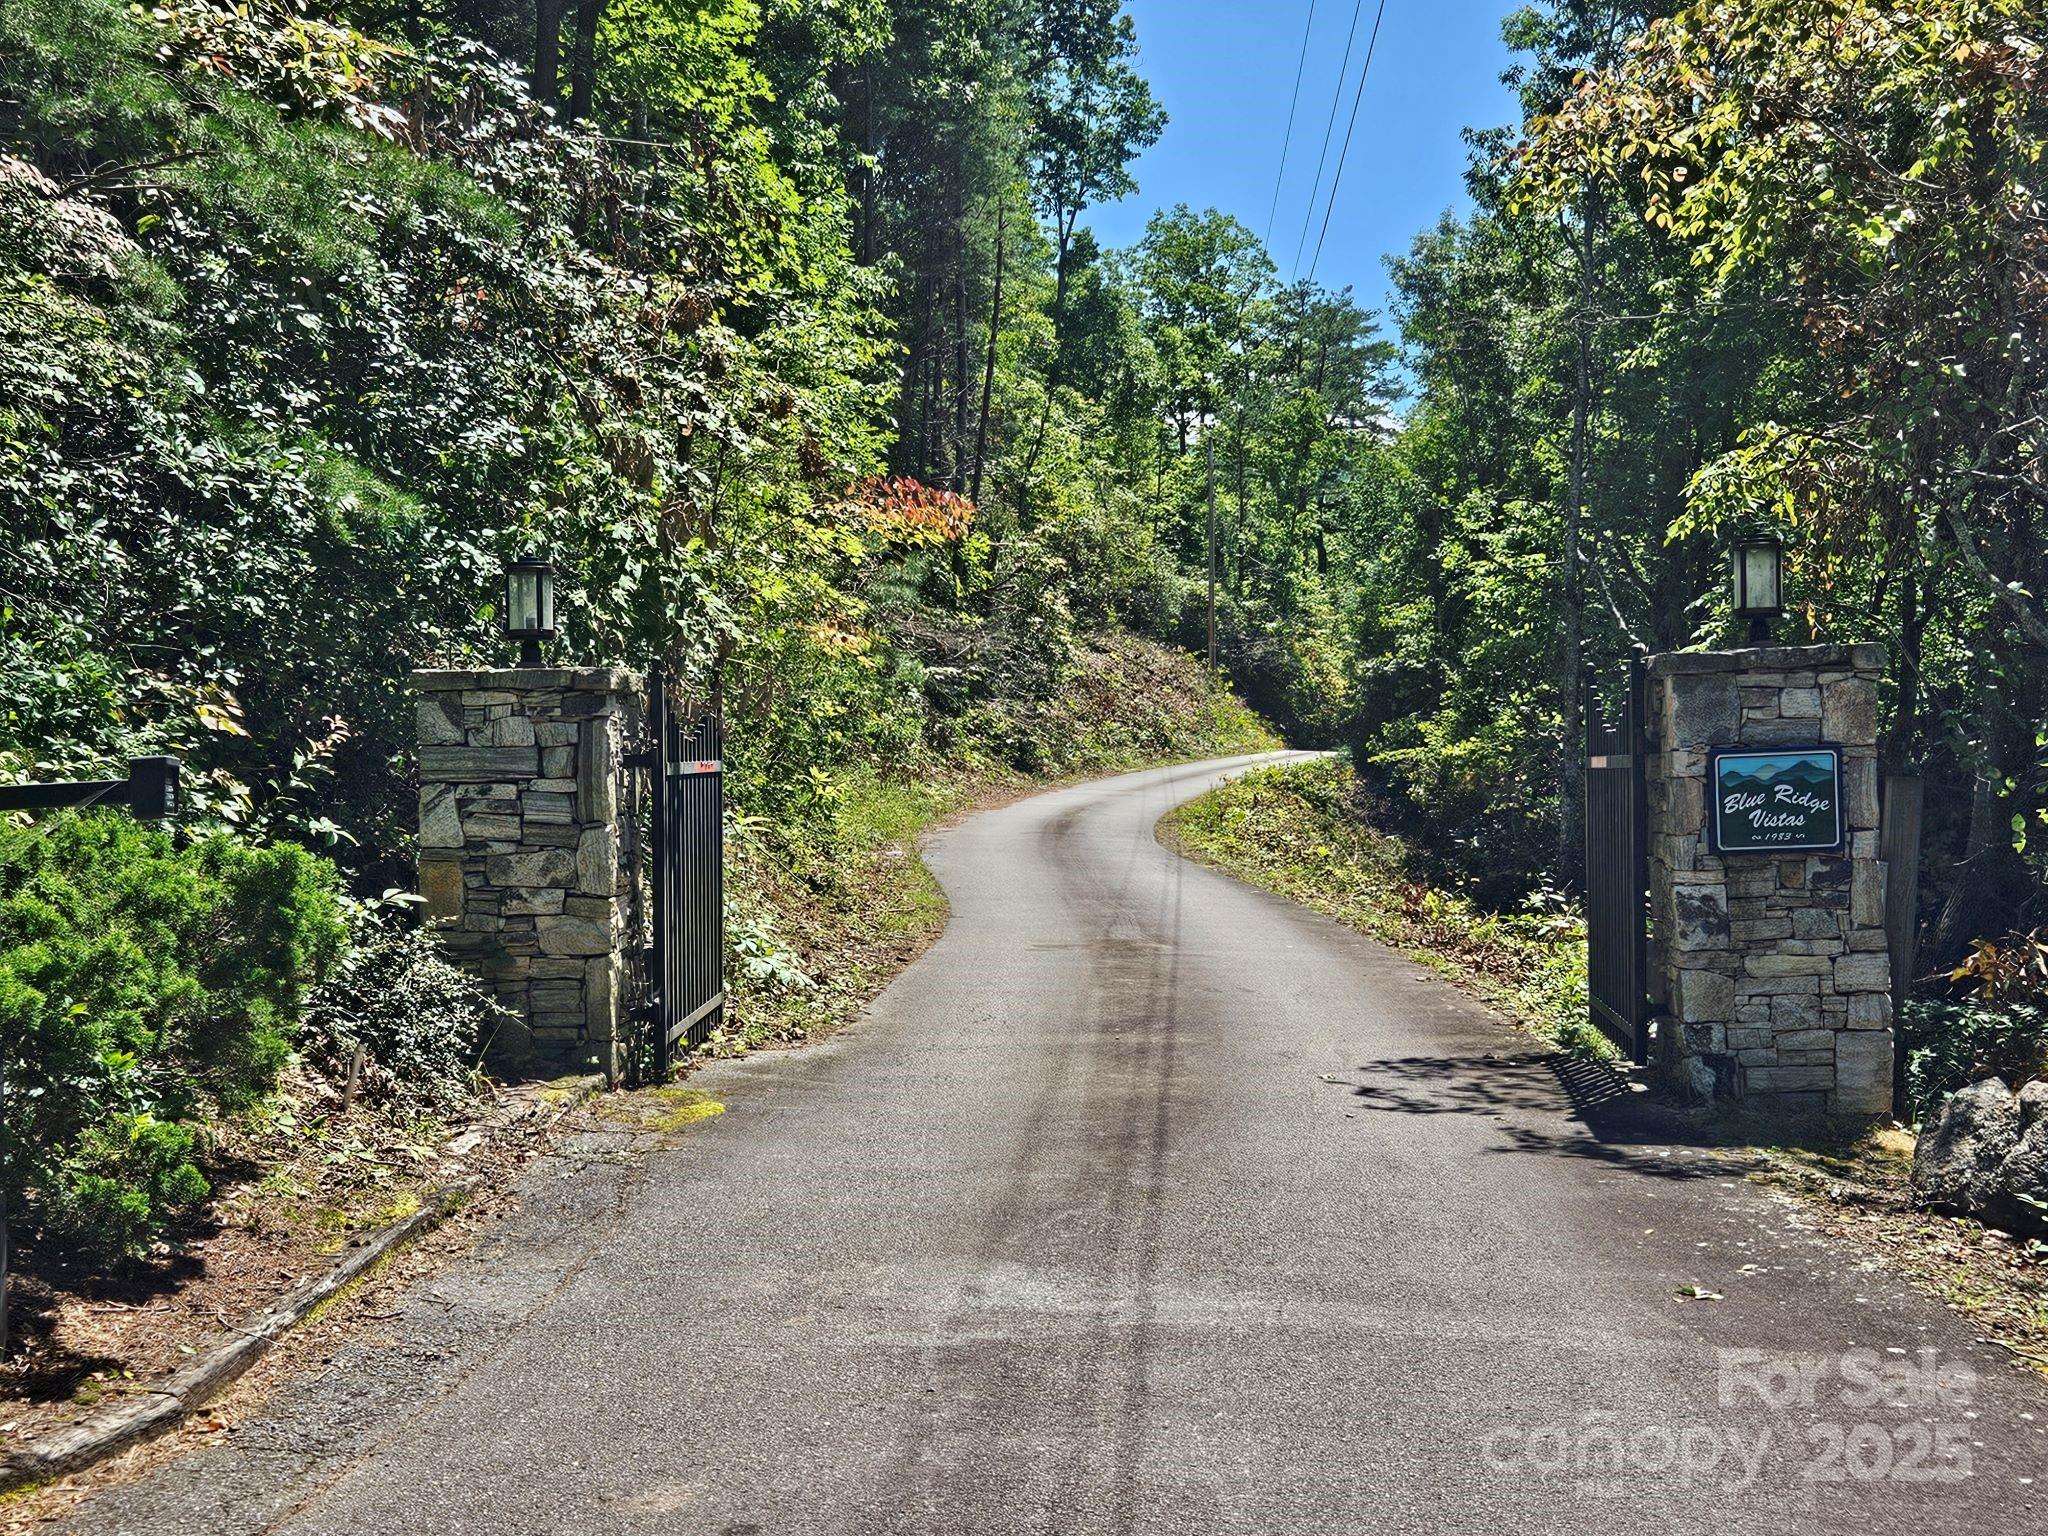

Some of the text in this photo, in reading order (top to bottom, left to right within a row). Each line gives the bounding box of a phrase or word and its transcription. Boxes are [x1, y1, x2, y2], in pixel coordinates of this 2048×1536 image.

[1723, 784, 1830, 813] Blue Ridge
[1748, 808, 1806, 828] Vistas
